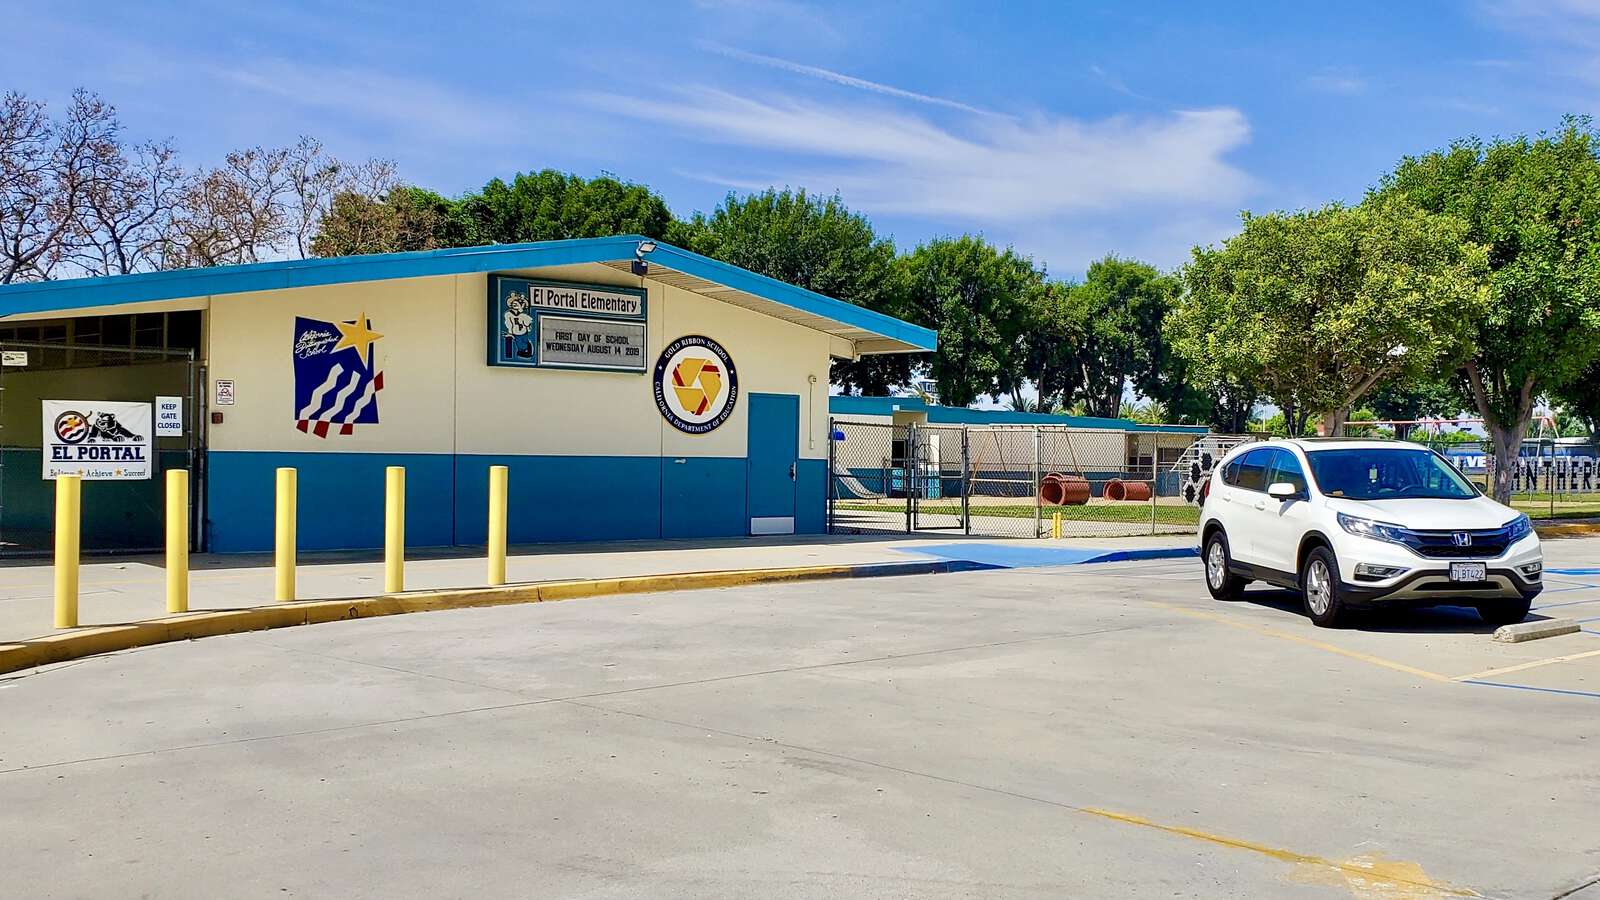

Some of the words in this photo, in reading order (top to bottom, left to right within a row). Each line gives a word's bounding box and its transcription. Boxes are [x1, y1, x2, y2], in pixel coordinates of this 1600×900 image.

[533, 288, 544, 305] El
[547, 289, 578, 309] Portal
[581, 294, 637, 313] Elementary
[555, 331, 573, 341] FIRST
[577, 332, 591, 342] DAY
[593, 334, 602, 343] OF
[605, 335, 629, 345] SCHOOL
[545, 342, 585, 353] WEDNESDAY
[587, 344, 611, 354] AUGUST
[614, 346, 621, 355] 14
[625, 347, 640, 356] 2019
[664, 342, 681, 359] GOLD
[680, 337, 706, 346] RIBBON
[706, 340, 729, 363] SCHOOL
[655, 381, 674, 422] CALIFORNIA
[673, 418, 712, 432] DEPARTMENT
[712, 419, 721, 427] OF
[720, 385, 737, 422] EDUCATION
[160, 412, 177, 420] GATE
[52, 446, 73, 460] EL
[77, 446, 145, 460] PORTAL
[86, 470, 113, 478] Achieve
[1511, 460, 1600, 491] ANTHER
